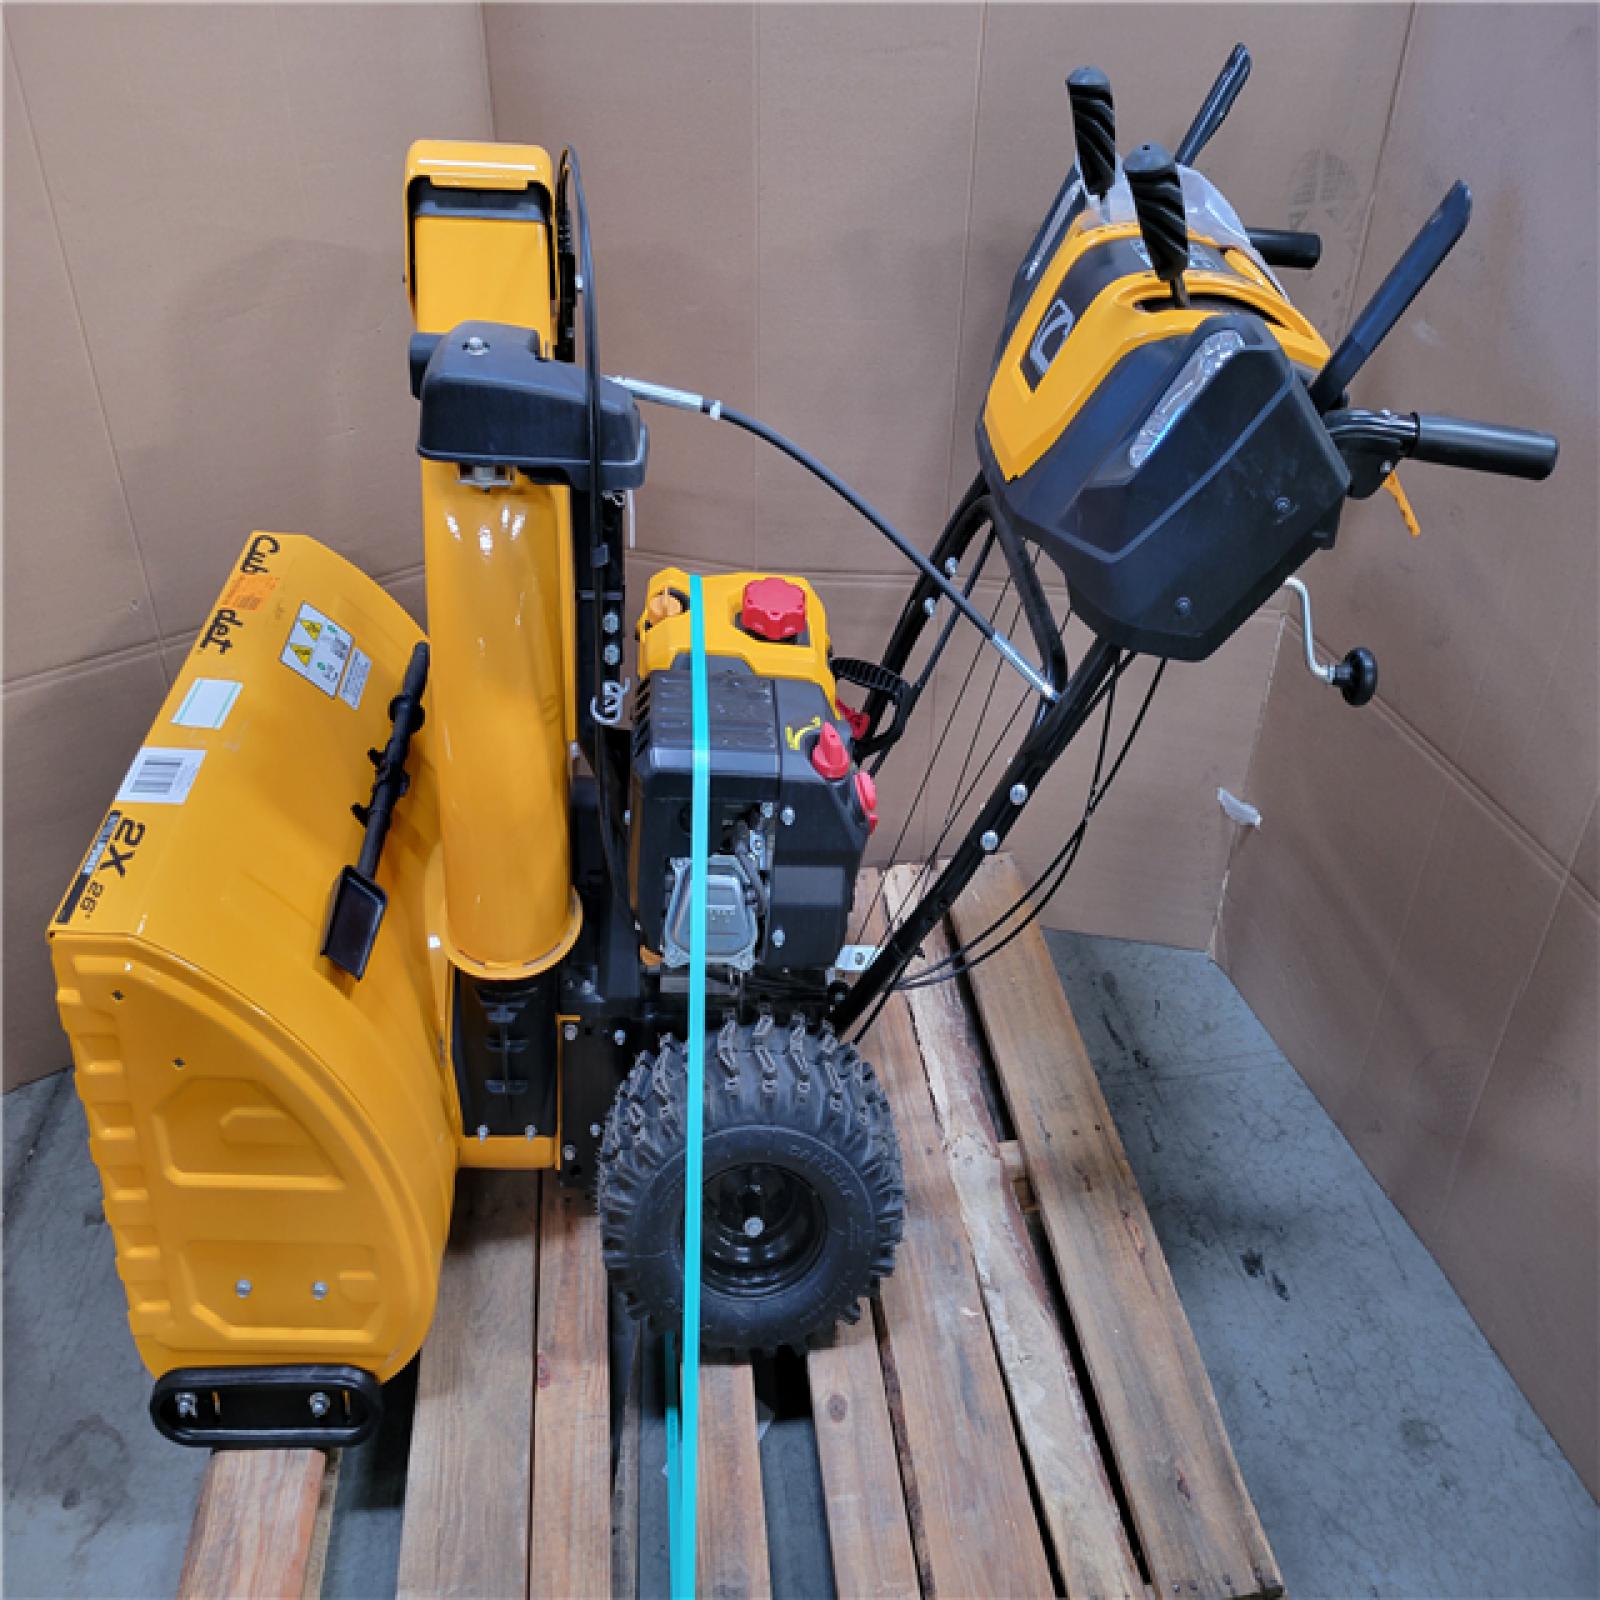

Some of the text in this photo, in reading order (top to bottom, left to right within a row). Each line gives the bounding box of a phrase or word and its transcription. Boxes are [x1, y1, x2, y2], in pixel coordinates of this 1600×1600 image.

[240, 535, 280, 574] Cub
[200, 609, 243, 654] det
[100, 818, 145, 877] 2X
